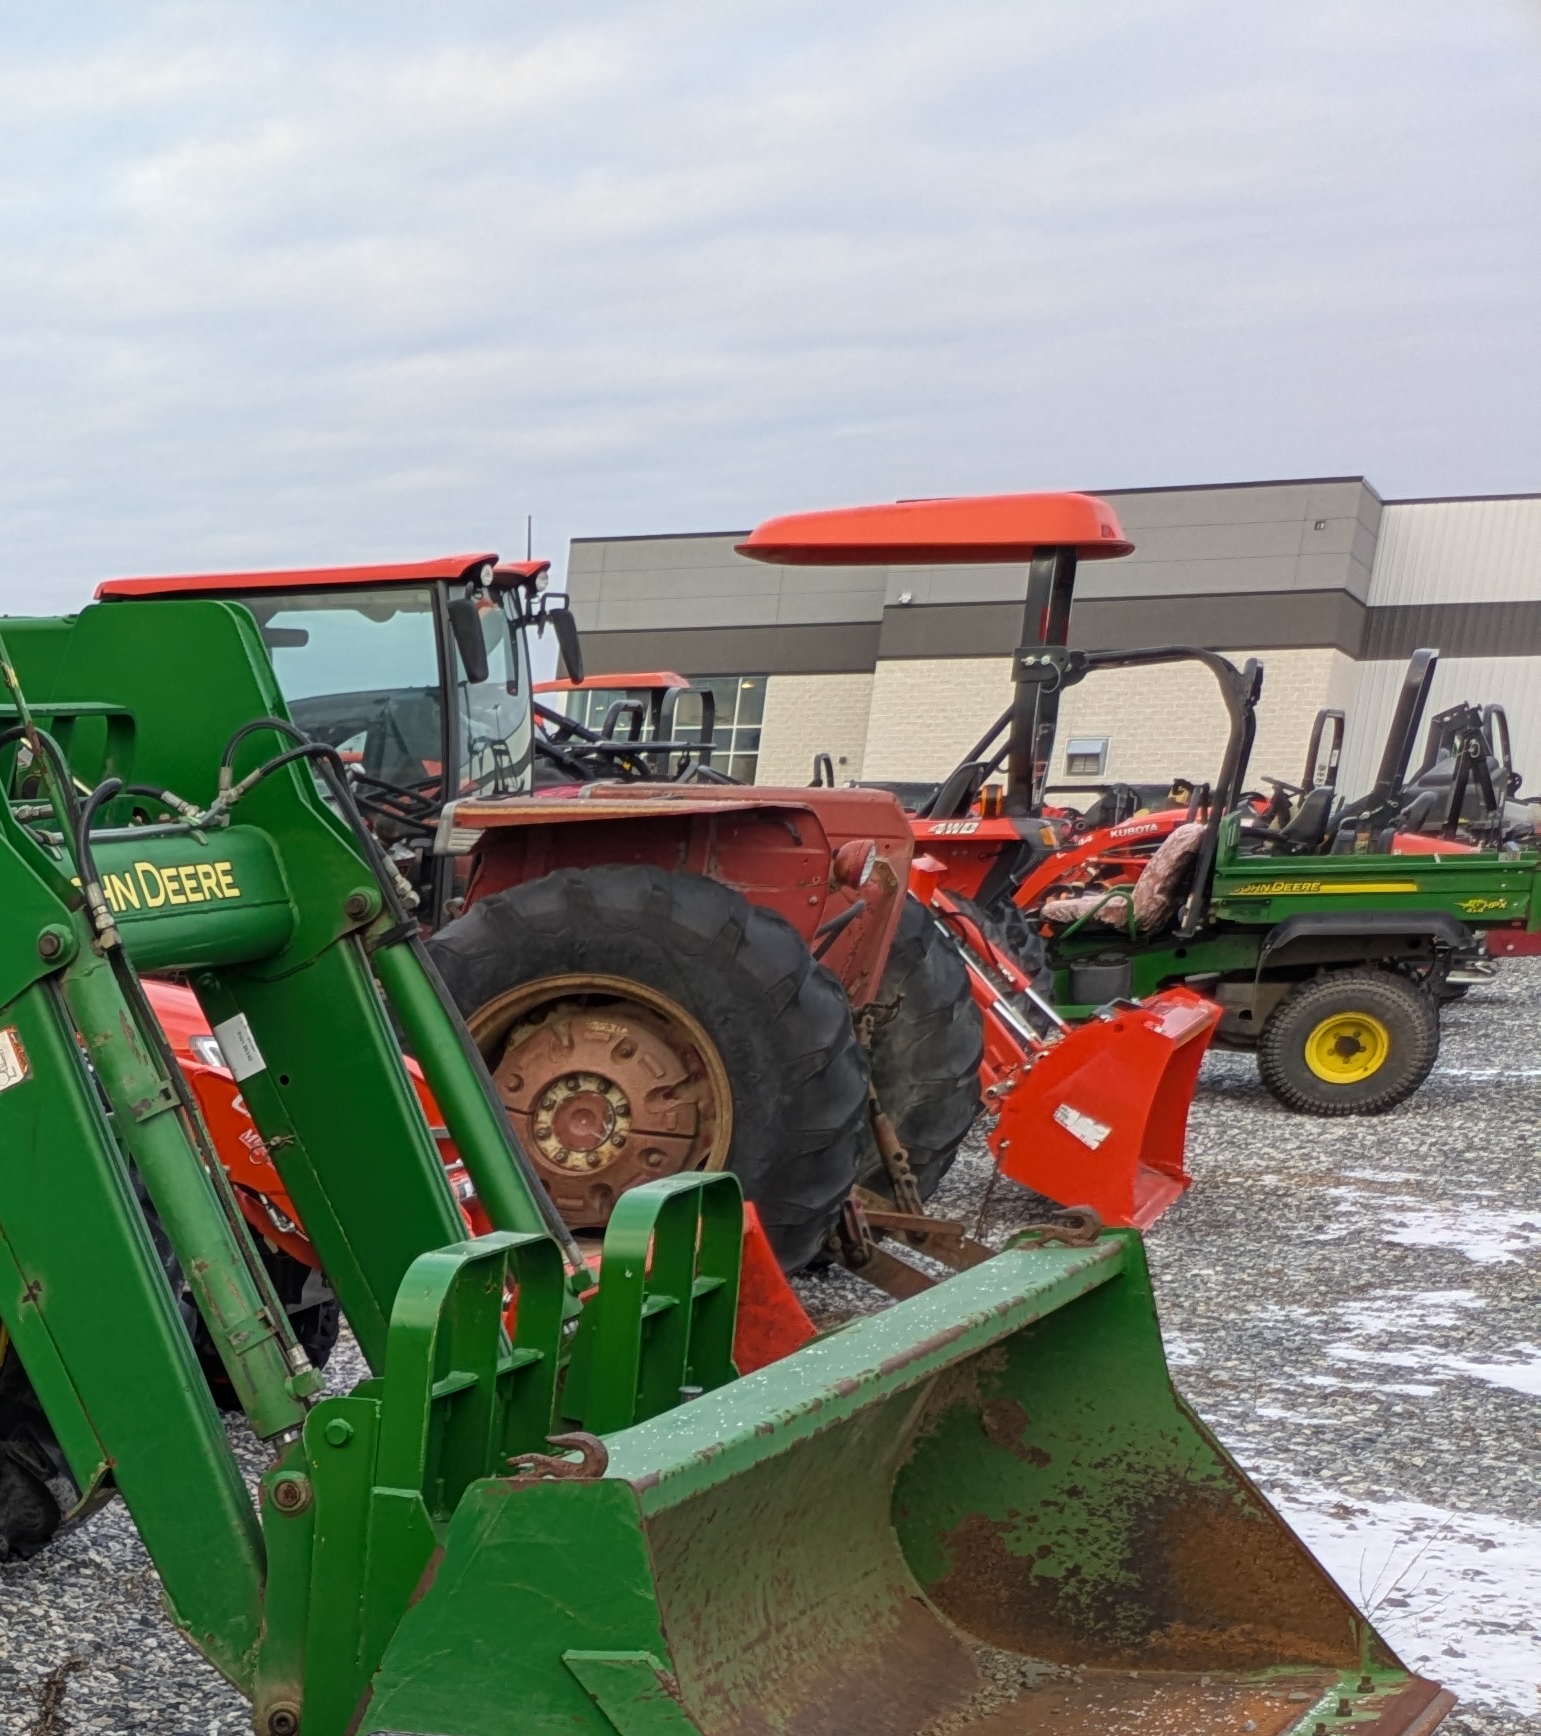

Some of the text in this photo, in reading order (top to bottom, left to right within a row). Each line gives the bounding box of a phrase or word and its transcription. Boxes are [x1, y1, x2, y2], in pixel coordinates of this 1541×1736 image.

[927, 822, 979, 835] 4WD
[1110, 823, 1158, 838] KUBOTA
[70, 860, 241, 912] HN DEERE
[1271, 881, 1321, 893] DEERE
